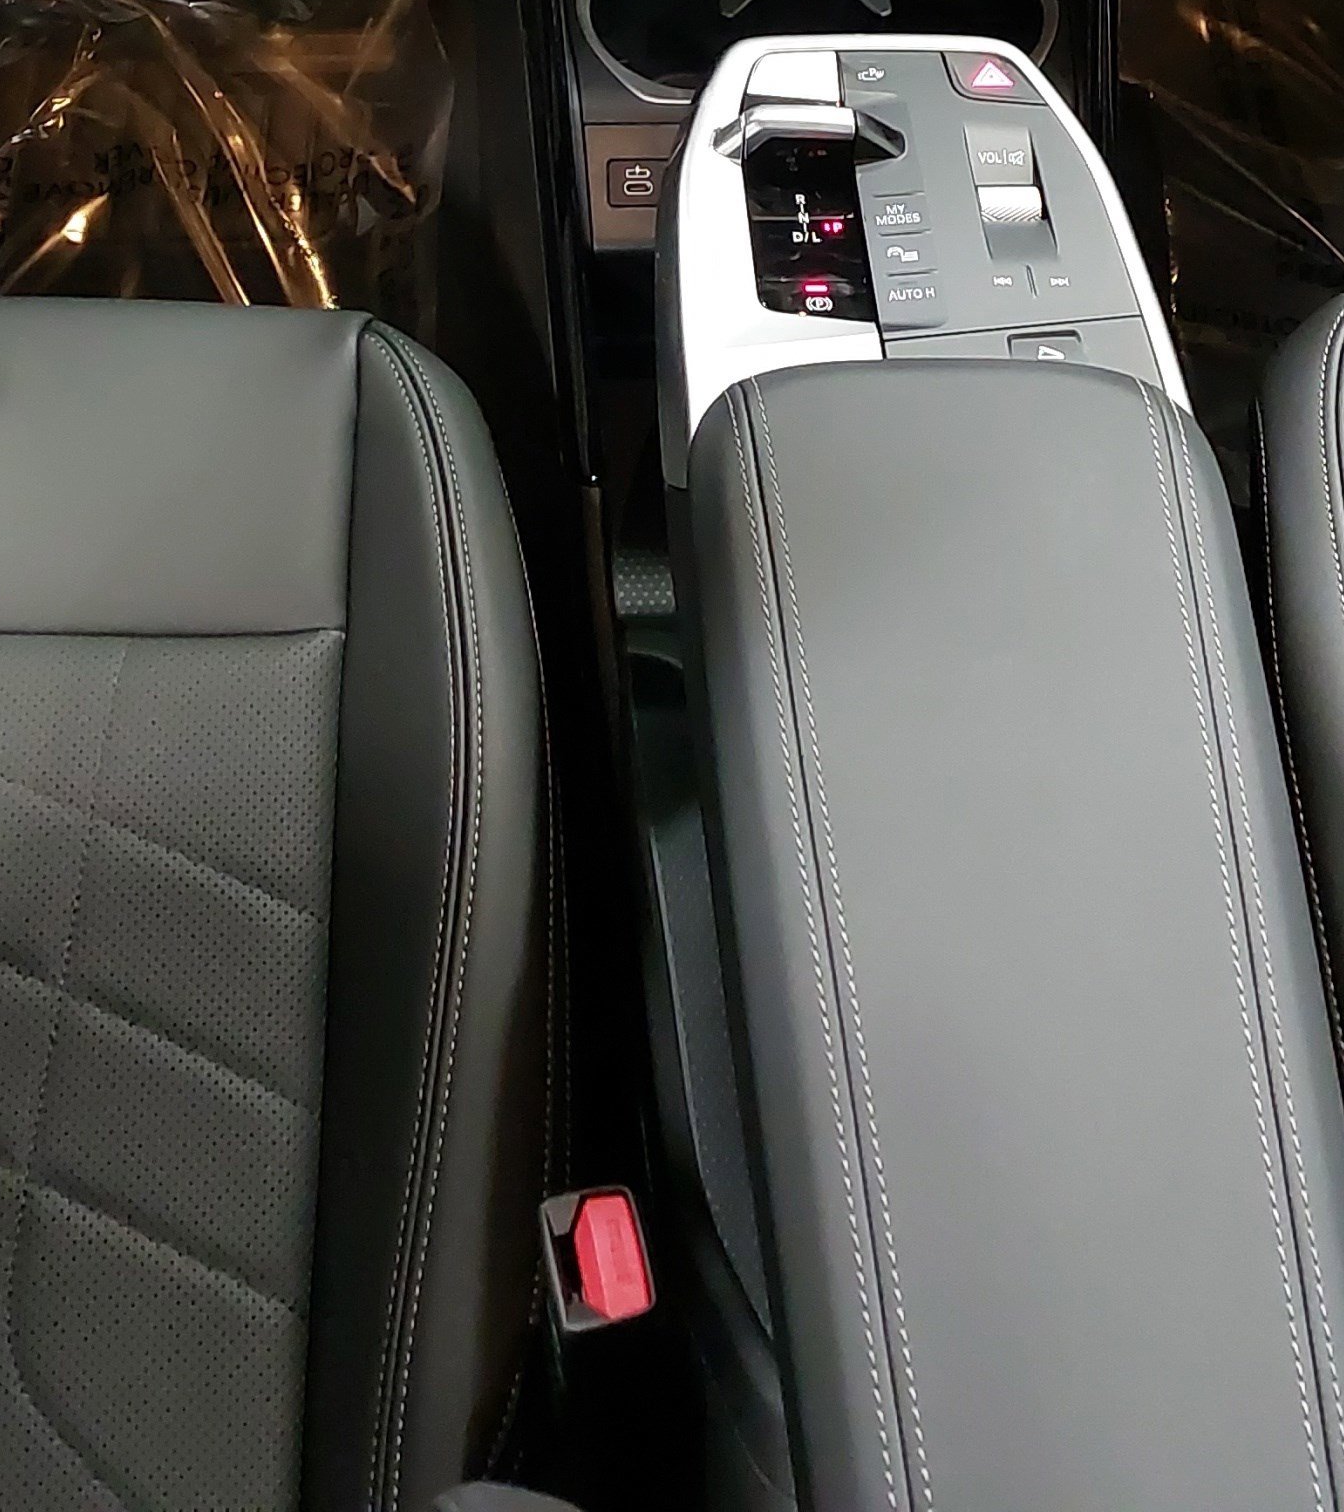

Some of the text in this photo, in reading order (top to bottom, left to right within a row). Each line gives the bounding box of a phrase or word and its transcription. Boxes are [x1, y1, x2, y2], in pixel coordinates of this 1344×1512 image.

[977, 151, 1003, 165] VOL
[795, 193, 806, 205] R
[885, 203, 906, 215] MY
[798, 211, 810, 224] N
[876, 212, 921, 226] MODES
[832, 221, 843, 233] P
[888, 286, 936, 302] AUTO H
